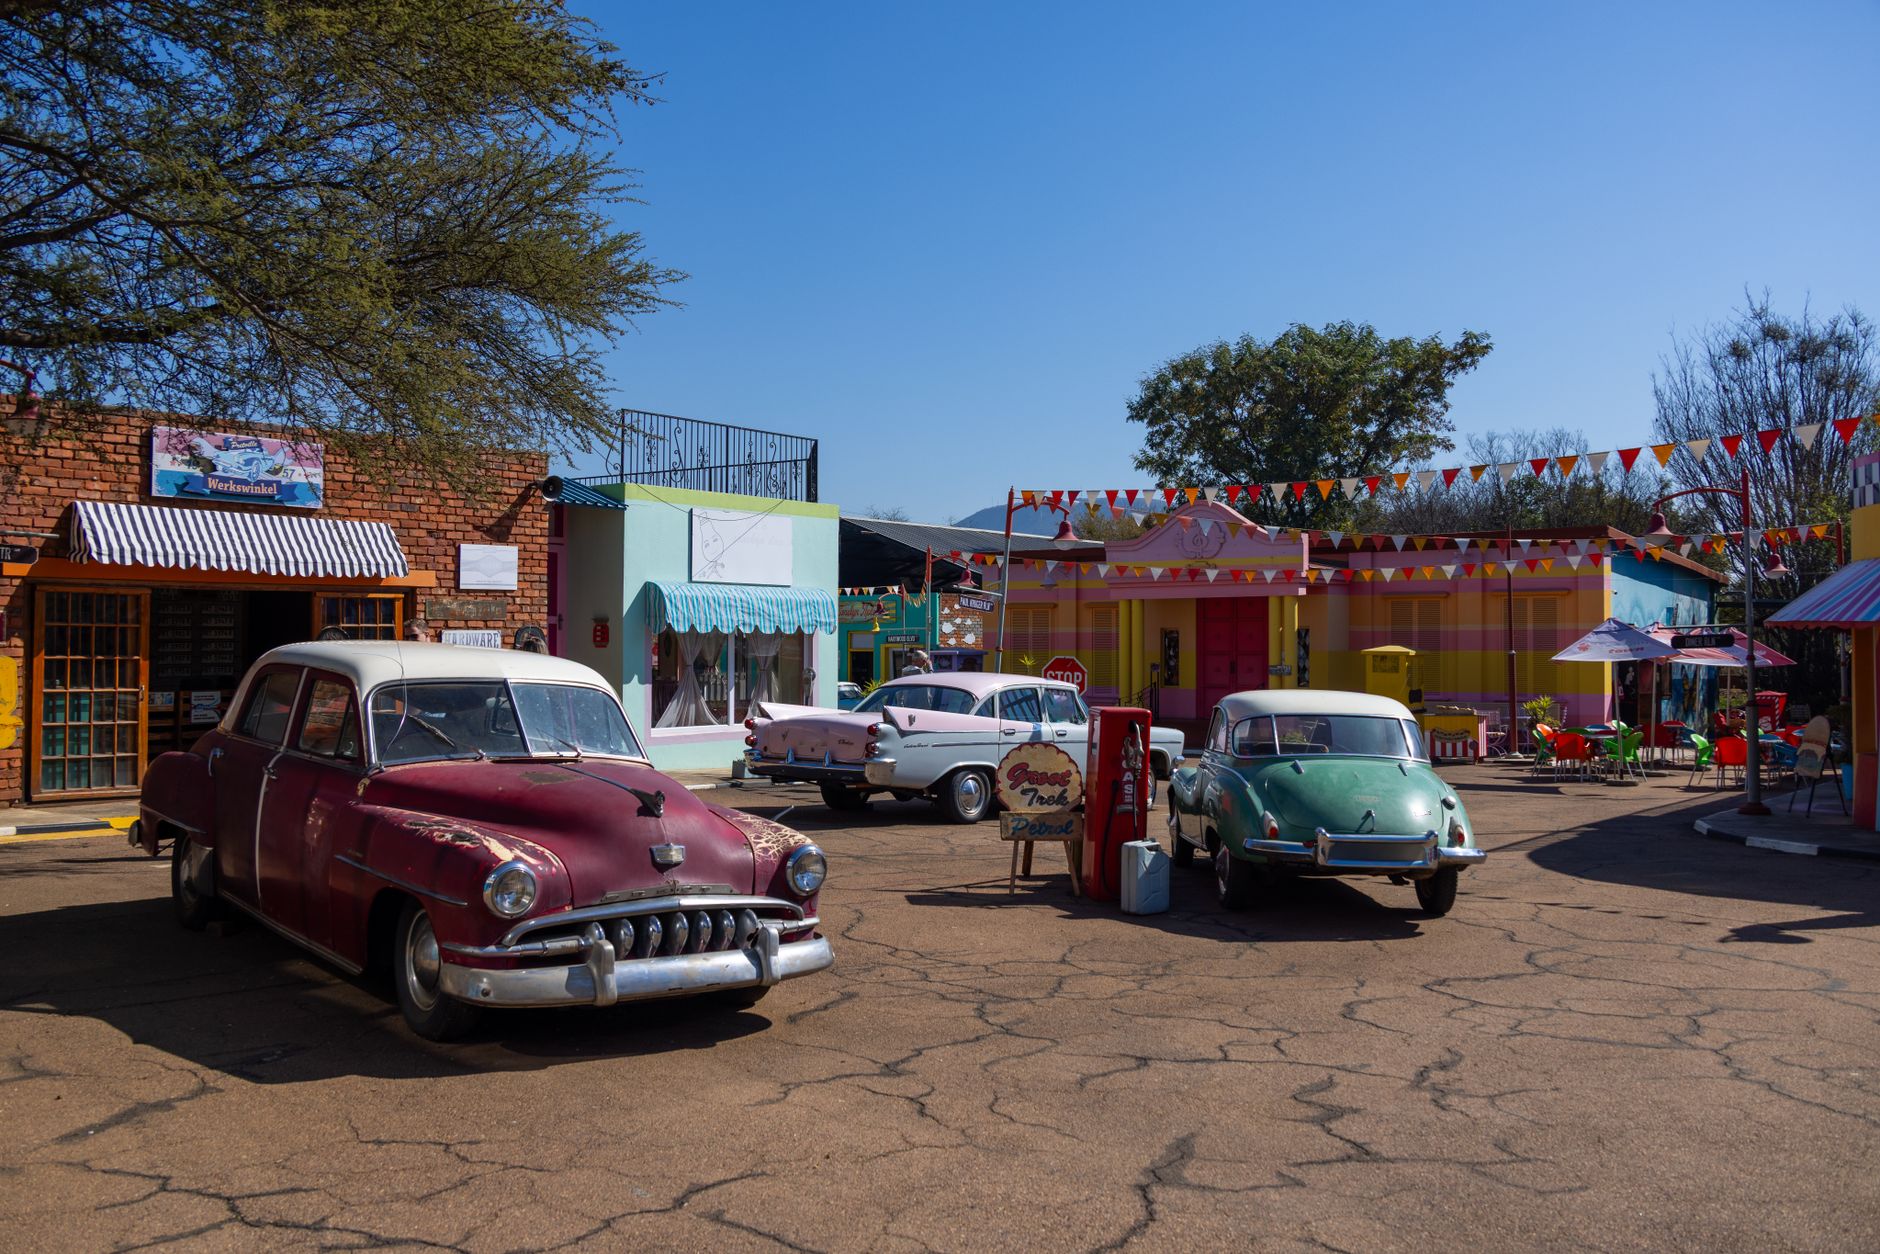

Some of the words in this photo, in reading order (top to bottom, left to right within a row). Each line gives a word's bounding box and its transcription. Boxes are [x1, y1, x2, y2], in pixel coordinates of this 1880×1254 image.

[283, 468, 296, 480] 57
[207, 477, 278, 495] Werkswinkel
[444, 632, 499, 648] HARDWARE
[1046, 670, 1083, 685] STOP
[1007, 762, 1072, 790] Groot
[1021, 787, 1069, 806] Trek
[1009, 817, 1073, 836] Petrol
